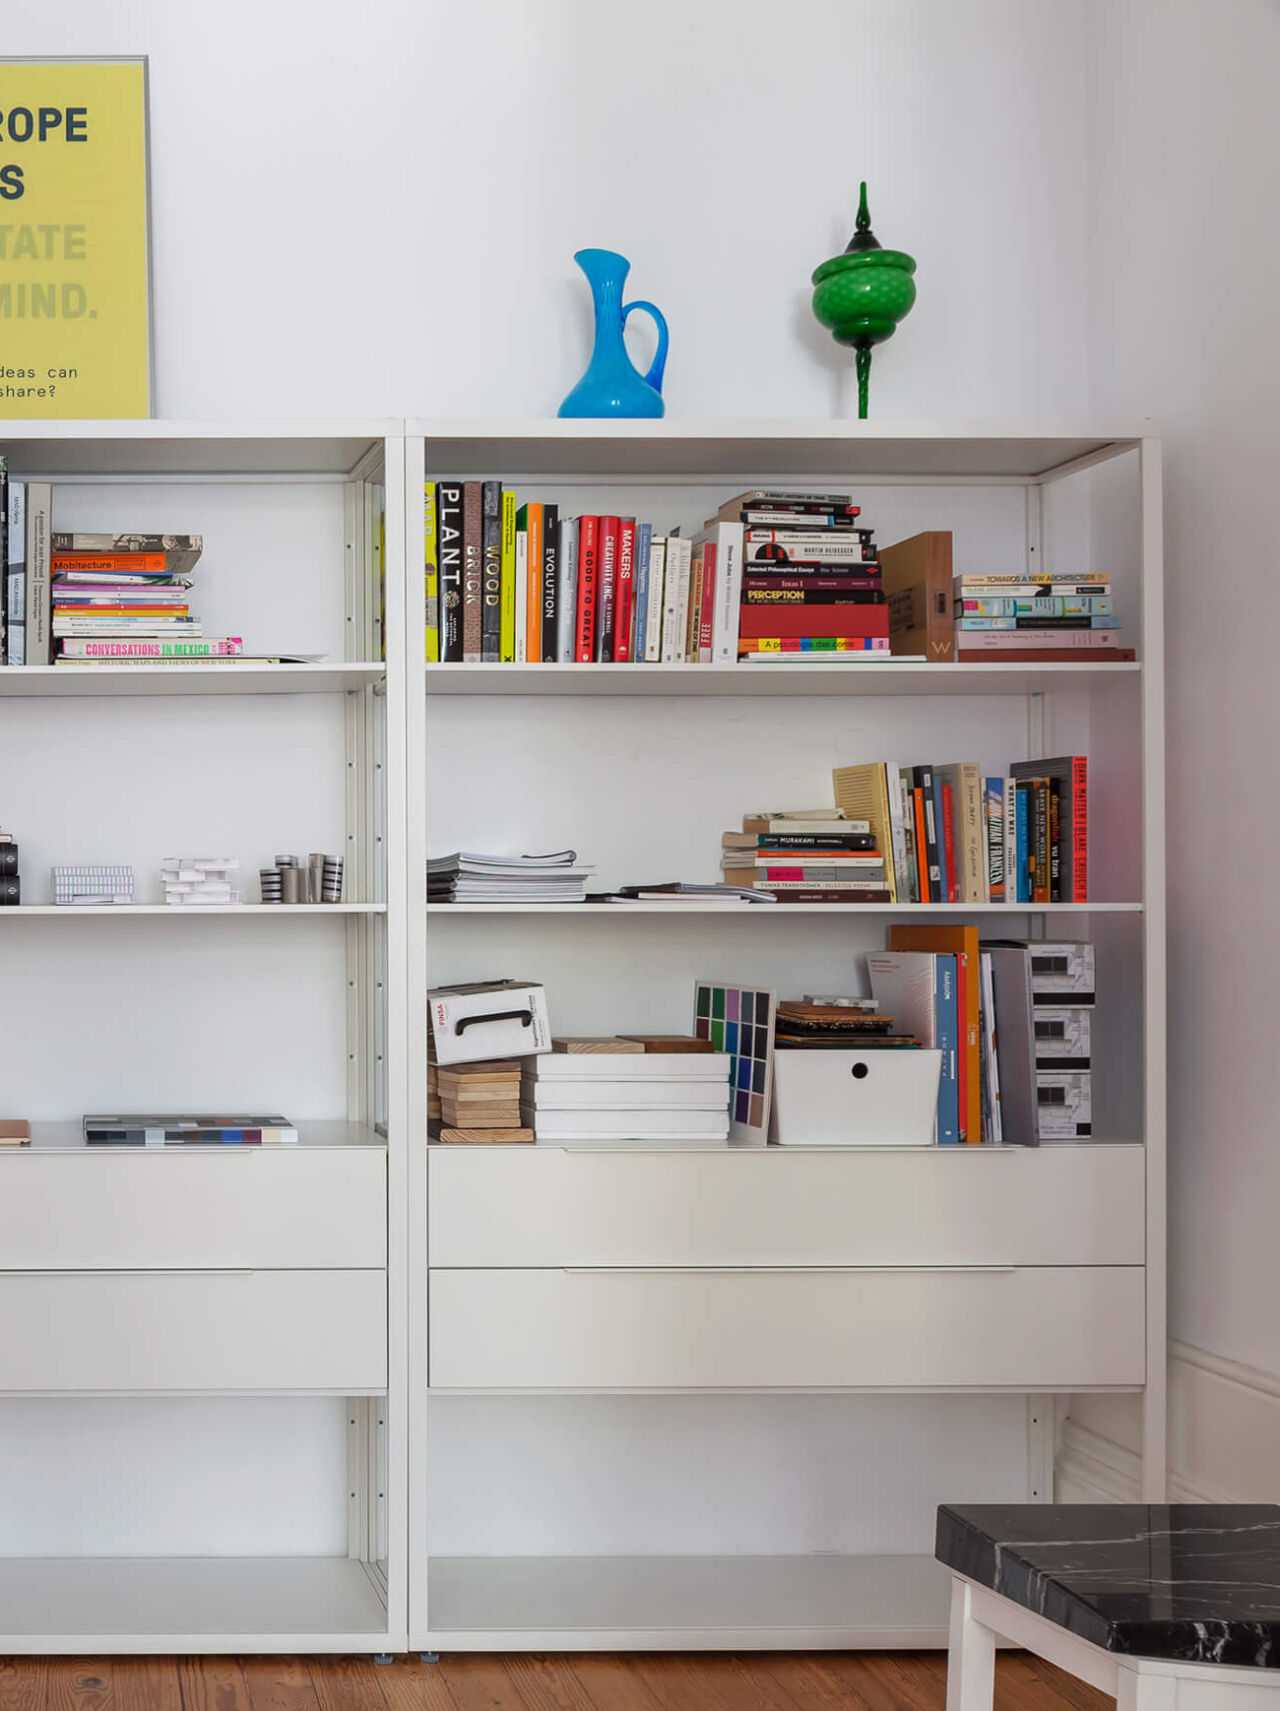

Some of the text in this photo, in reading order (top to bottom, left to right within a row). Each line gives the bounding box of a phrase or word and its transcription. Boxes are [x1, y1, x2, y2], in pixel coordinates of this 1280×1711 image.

[47, 368, 77, 379] can
[442, 489, 460, 585] PLANT
[54, 560, 112, 570] Mobitecture
[603, 536, 614, 601] CREATIVITY, INC.
[621, 530, 632, 579] MAKERS
[679, 556, 688, 580] blink
[466, 546, 480, 604] BRICK
[486, 545, 499, 607] WOOD
[545, 548, 555, 618] EVOLUTION
[585, 590, 592, 603] TO
[748, 590, 804, 599] PERCEPTION
[582, 611, 591, 648] GREAT
[700, 623, 712, 643] FREE
[86, 644, 209, 655] CONVERSATIONS IN MEXICO
[931, 641, 952, 654] W
[1008, 809, 1014, 817] IT
[1050, 794, 1059, 842] dragonfish
[1074, 763, 1086, 890] DARK MATTER BLAKE CROUCH
[989, 800, 1003, 885] JONATHAN FRANZEN
[1051, 846, 1058, 857] vu
